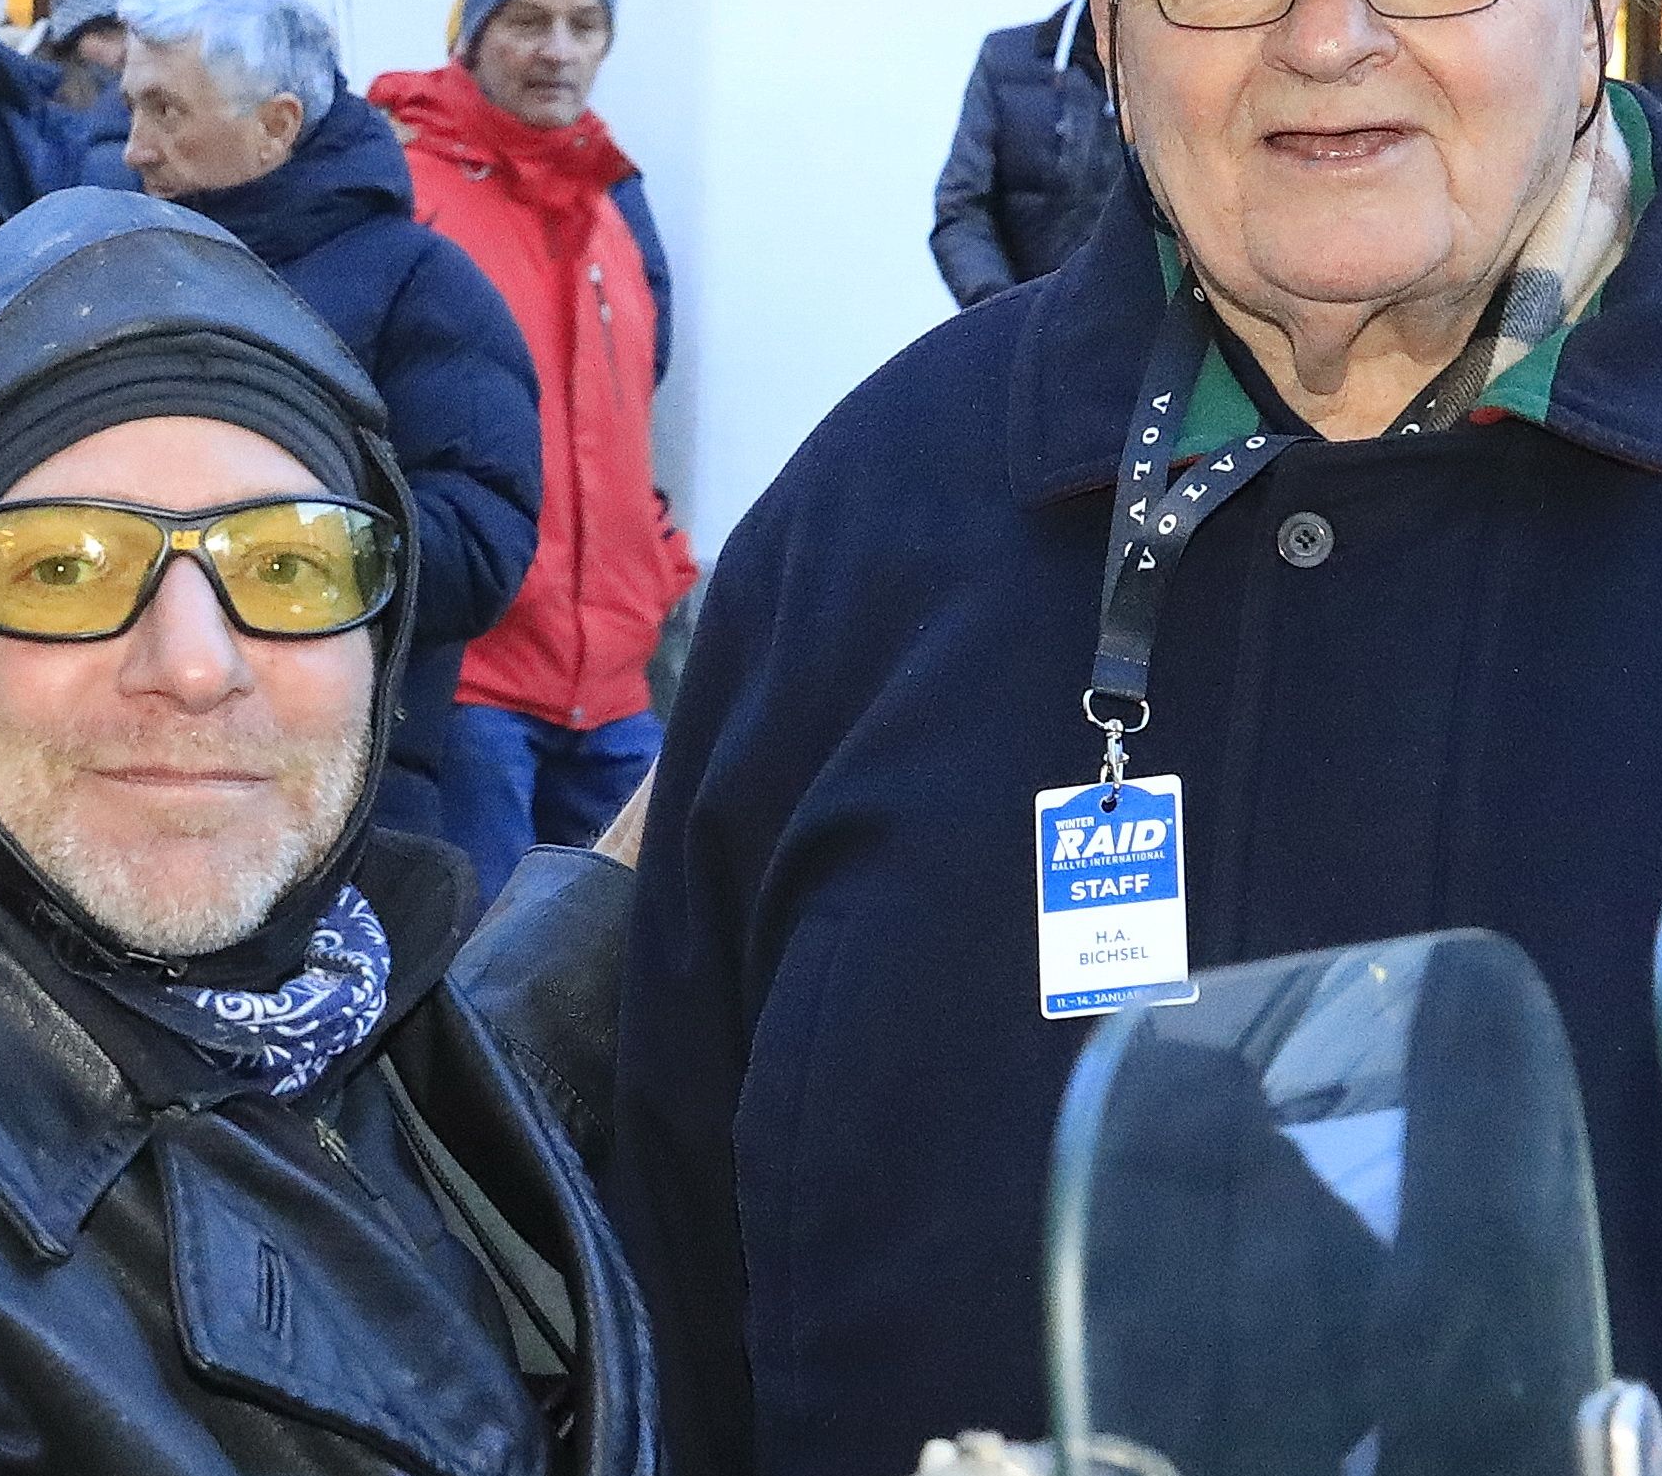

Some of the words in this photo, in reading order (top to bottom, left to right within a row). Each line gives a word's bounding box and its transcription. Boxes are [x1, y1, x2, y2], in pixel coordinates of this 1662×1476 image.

[1136, 435, 1266, 572] VOLVO
[1055, 816, 1095, 830] WINTER
[1052, 819, 1169, 862] RAID
[1051, 860, 1087, 871] RALLYE
[1090, 850, 1166, 867] INTERNATIONAL
[1070, 873, 1151, 901] STAFF
[1096, 929, 1131, 944] H.A.
[1079, 946, 1150, 965] BICHSEL
